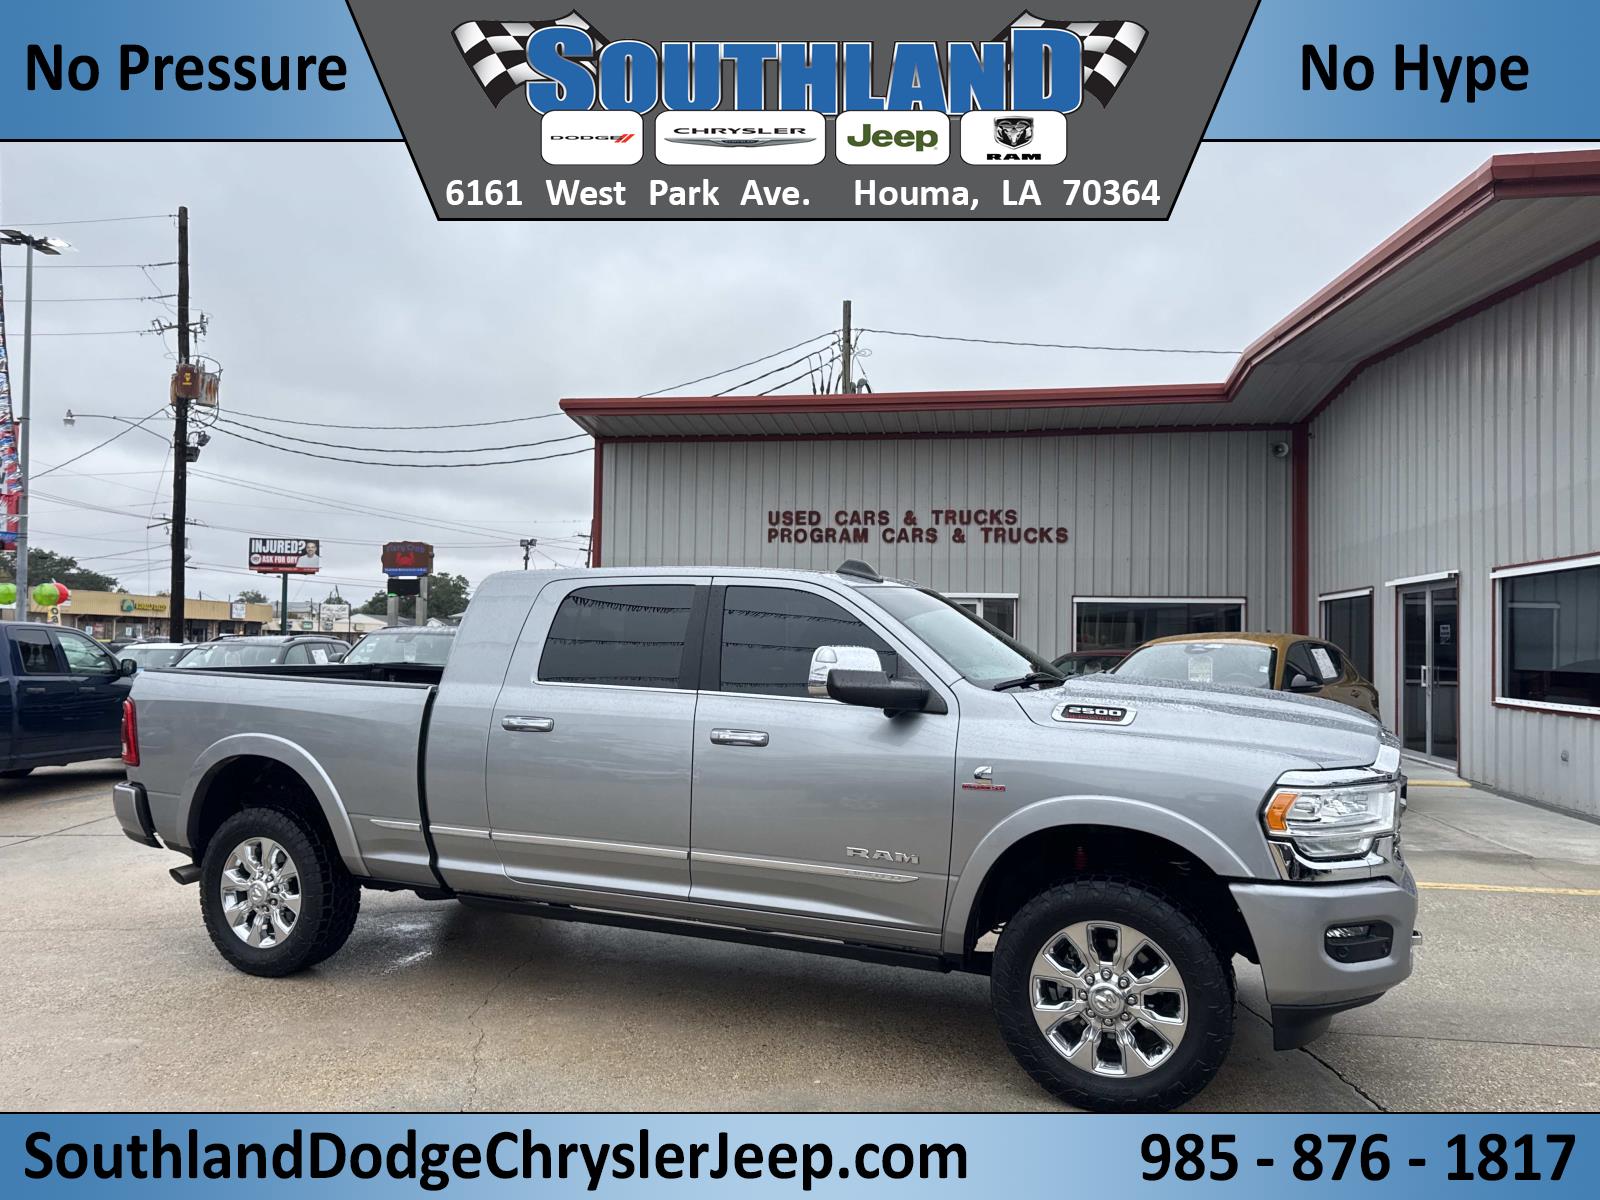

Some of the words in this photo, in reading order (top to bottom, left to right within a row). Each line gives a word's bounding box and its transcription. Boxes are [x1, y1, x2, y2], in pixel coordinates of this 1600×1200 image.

[768, 510, 822, 526] USED
[834, 510, 890, 526] CARS
[903, 510, 917, 526] &
[931, 508, 1018, 526] TRUCKS
[767, 527, 869, 544] PROGRAM
[882, 528, 938, 544] CARS
[952, 528, 966, 544] &
[980, 527, 1069, 544] TRUCKS
[251, 539, 306, 554] INJURED?
[1068, 706, 1122, 717] 2500
[846, 846, 920, 864] RAM
